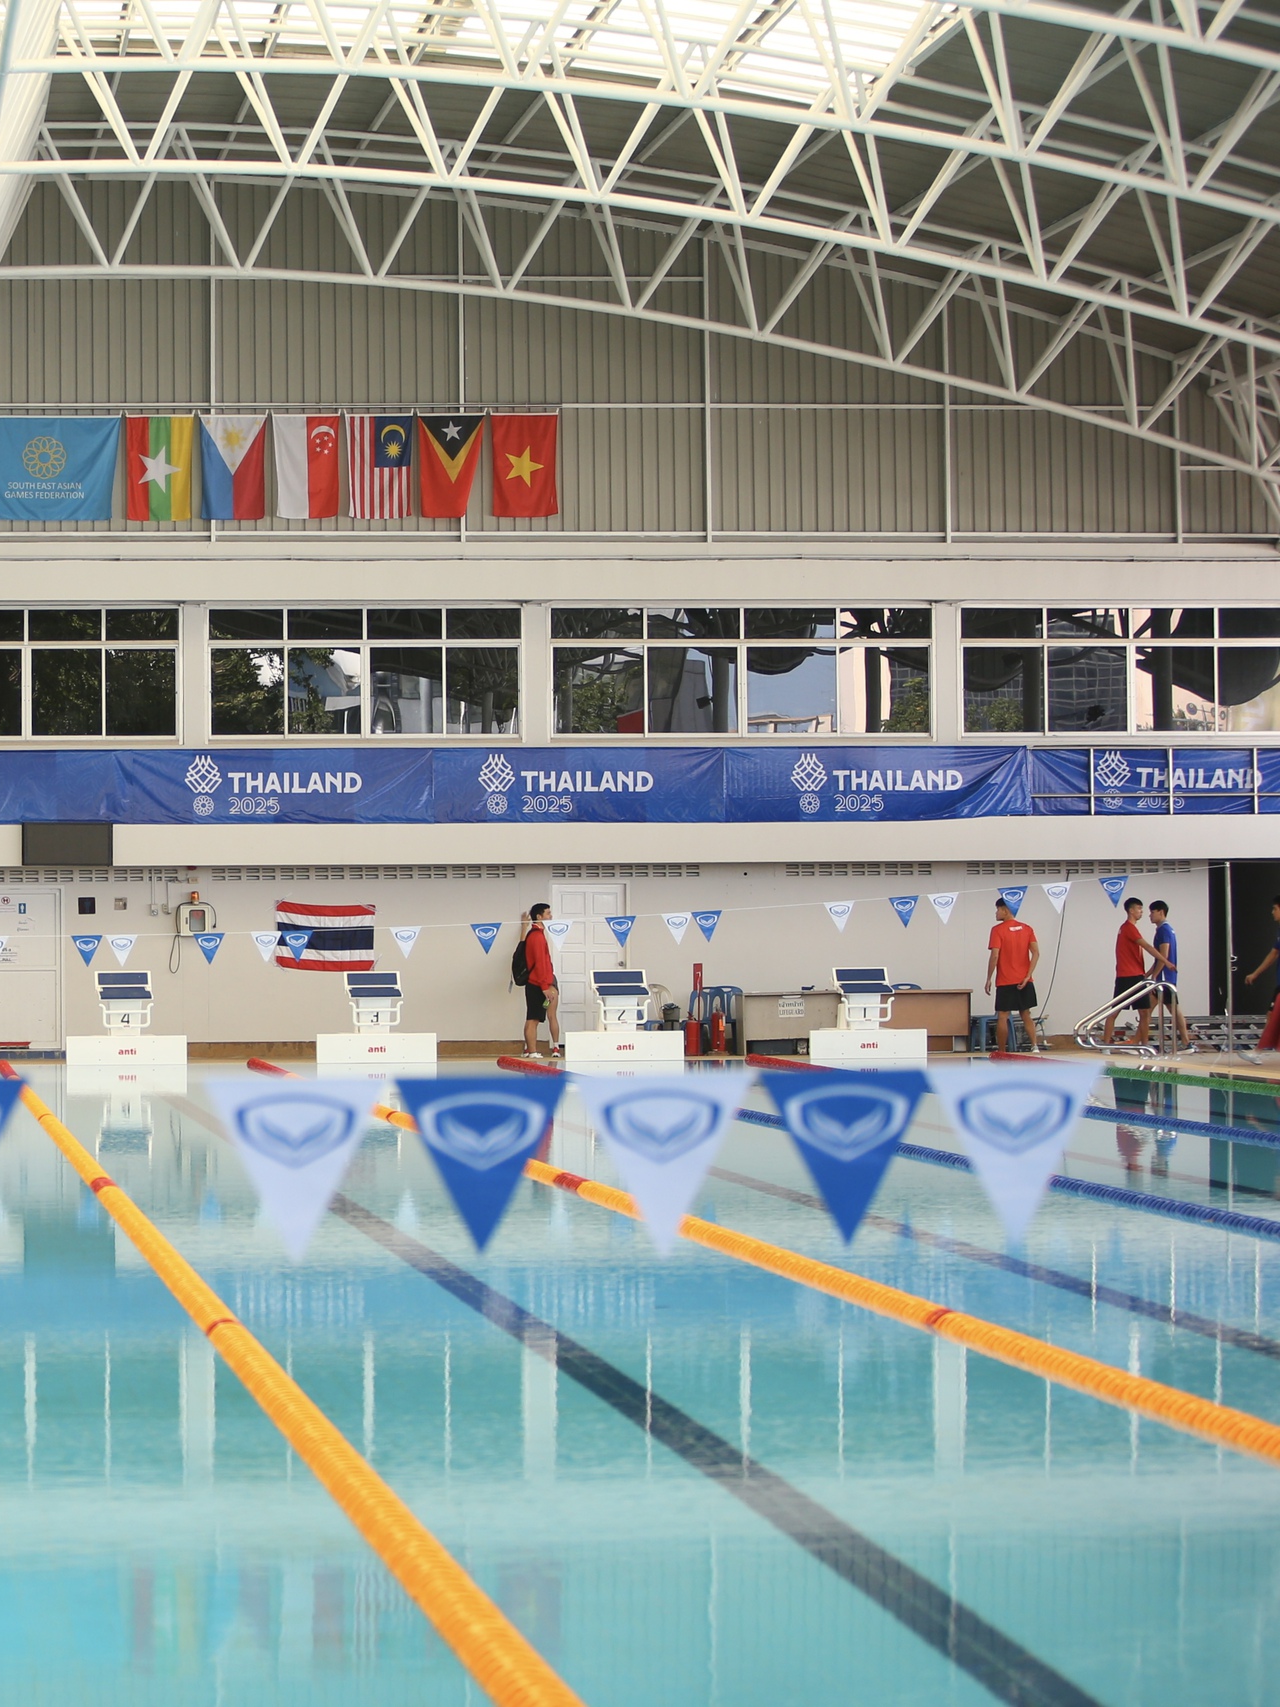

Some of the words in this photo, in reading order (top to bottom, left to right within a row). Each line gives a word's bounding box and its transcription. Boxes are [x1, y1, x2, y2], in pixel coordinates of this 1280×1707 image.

[7, 481, 35, 490] SOUTH
[36, 482, 56, 490] EAST
[56, 482, 82, 490] ASIAN
[4, 491, 34, 499] GAMES
[35, 491, 85, 499] FEDERATION
[228, 771, 363, 794] THAILAND
[521, 770, 654, 792] THAILAND
[833, 769, 963, 791] THAILAND
[1136, 767, 1263, 789] THAILAND
[228, 796, 281, 815] 2025
[522, 794, 573, 813] 2025
[834, 793, 884, 812] 2025
[120, 1013, 130, 1024] 4
[118, 1047, 137, 1055] anti
[367, 1045, 386, 1053] anti
[616, 1043, 635, 1051] anti
[860, 1041, 878, 1049] anti
